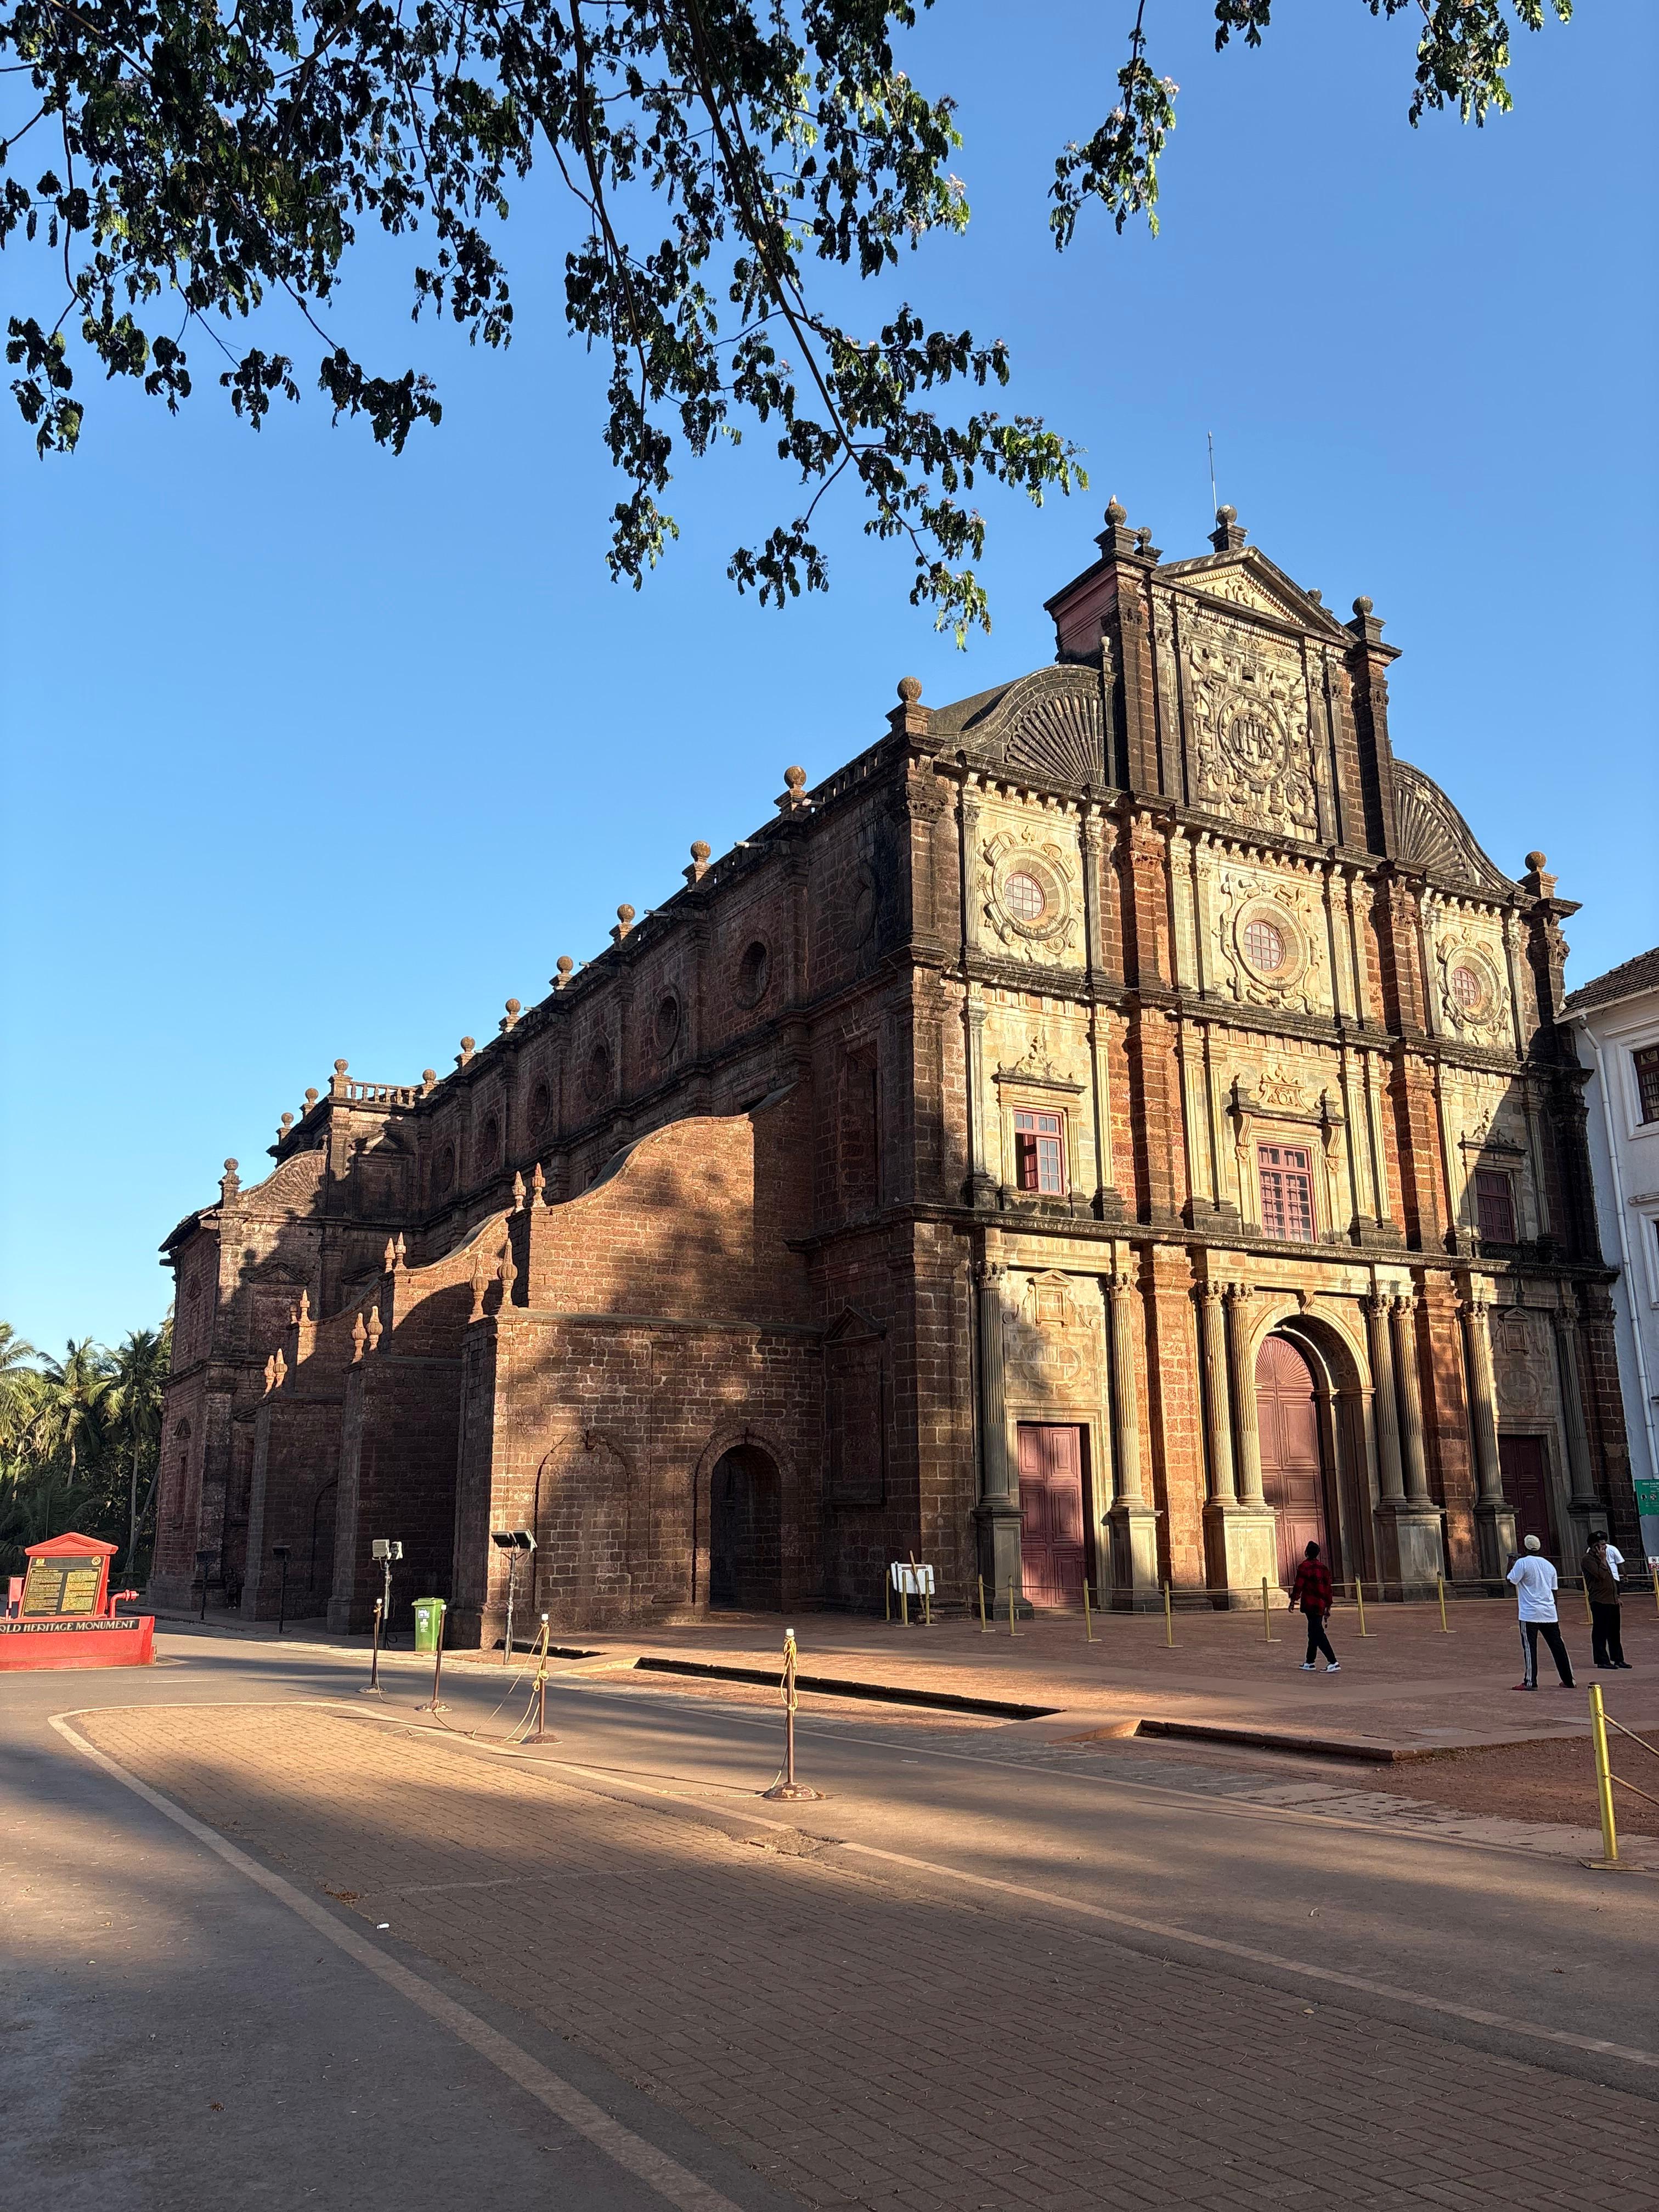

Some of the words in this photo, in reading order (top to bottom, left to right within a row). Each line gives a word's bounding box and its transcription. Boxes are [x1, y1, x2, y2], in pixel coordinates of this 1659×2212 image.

[1235, 715, 1274, 760] IHS
[22, 1622, 74, 1633] HERITAGE
[75, 1620, 135, 1630] MONUMENT
